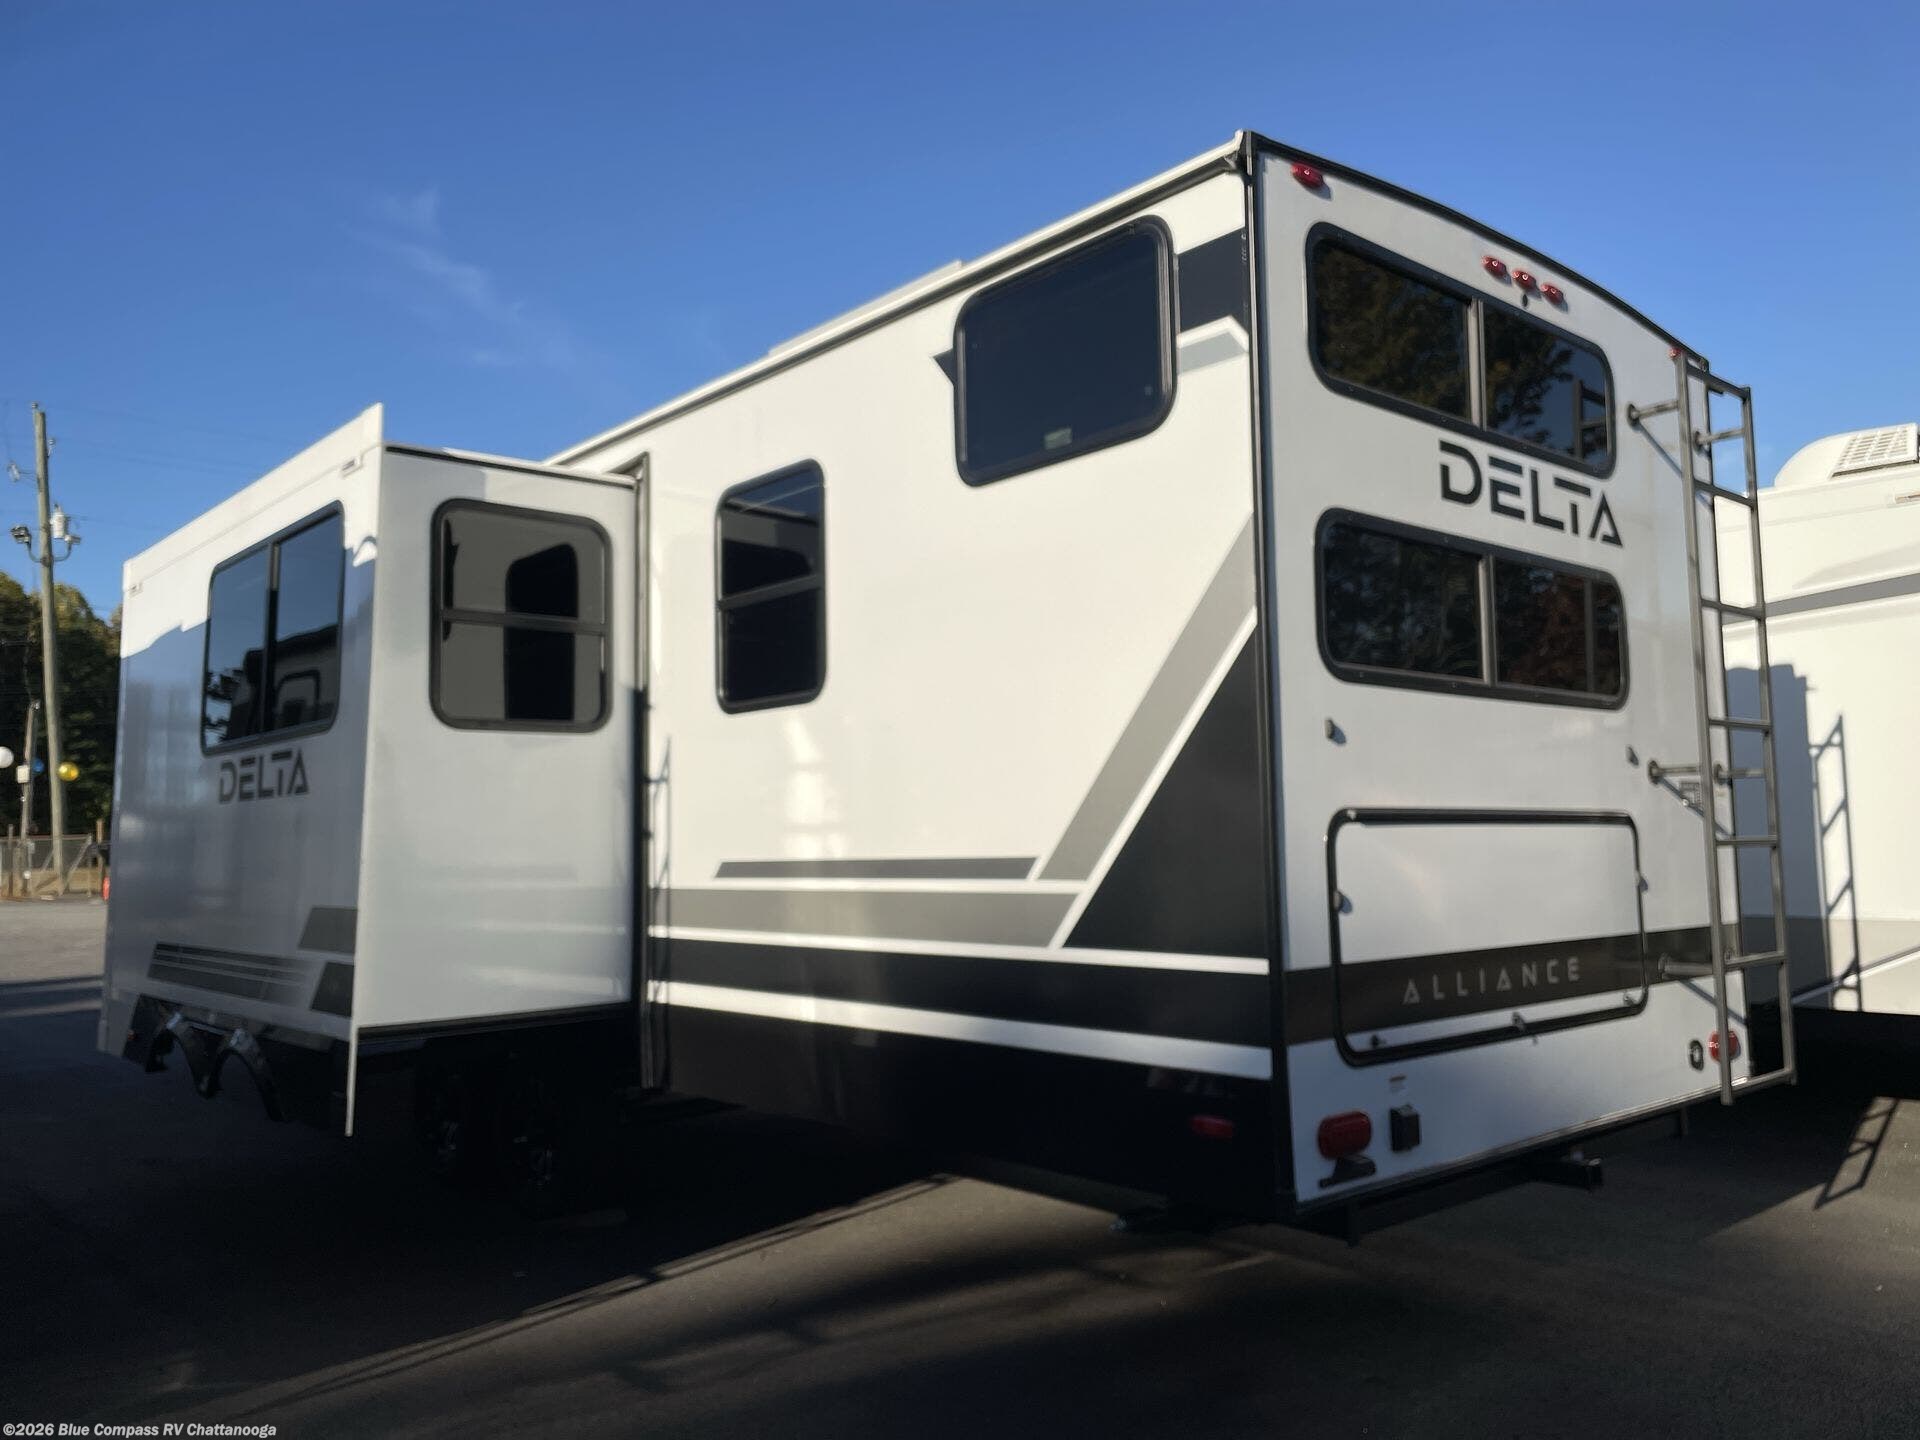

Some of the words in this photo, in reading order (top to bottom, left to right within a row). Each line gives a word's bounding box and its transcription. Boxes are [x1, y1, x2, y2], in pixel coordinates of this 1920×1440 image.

[1439, 439, 1623, 548] DELTA
[218, 747, 310, 804] DELTA
[1402, 956, 1581, 1006] ALLIANCE
